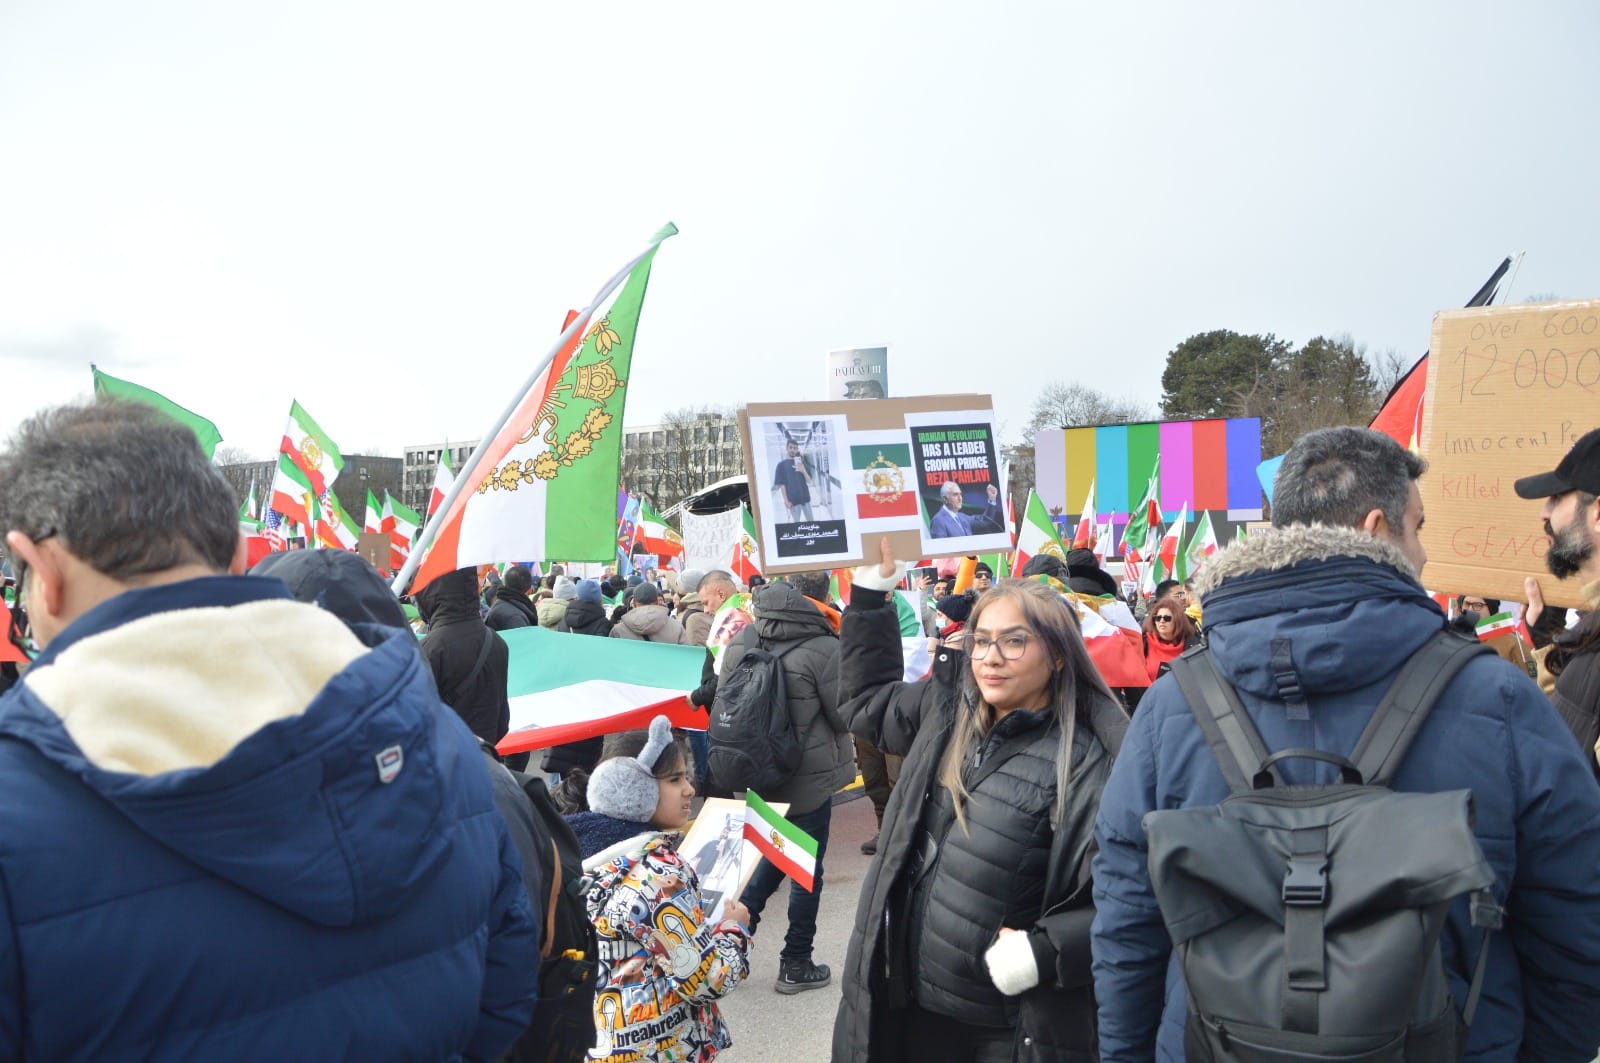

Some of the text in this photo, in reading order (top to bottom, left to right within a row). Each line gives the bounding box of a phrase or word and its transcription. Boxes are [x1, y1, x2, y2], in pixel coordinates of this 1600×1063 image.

[917, 429, 988, 443] IRANIAN REVOLUTION
[1561, 420, 1578, 445] Pe
[921, 440, 986, 458] HAS A LEADER
[924, 455, 989, 473] CROWN PRINCE
[926, 468, 991, 487] REZA PAHLAVI
[1451, 525, 1551, 559] GENO
